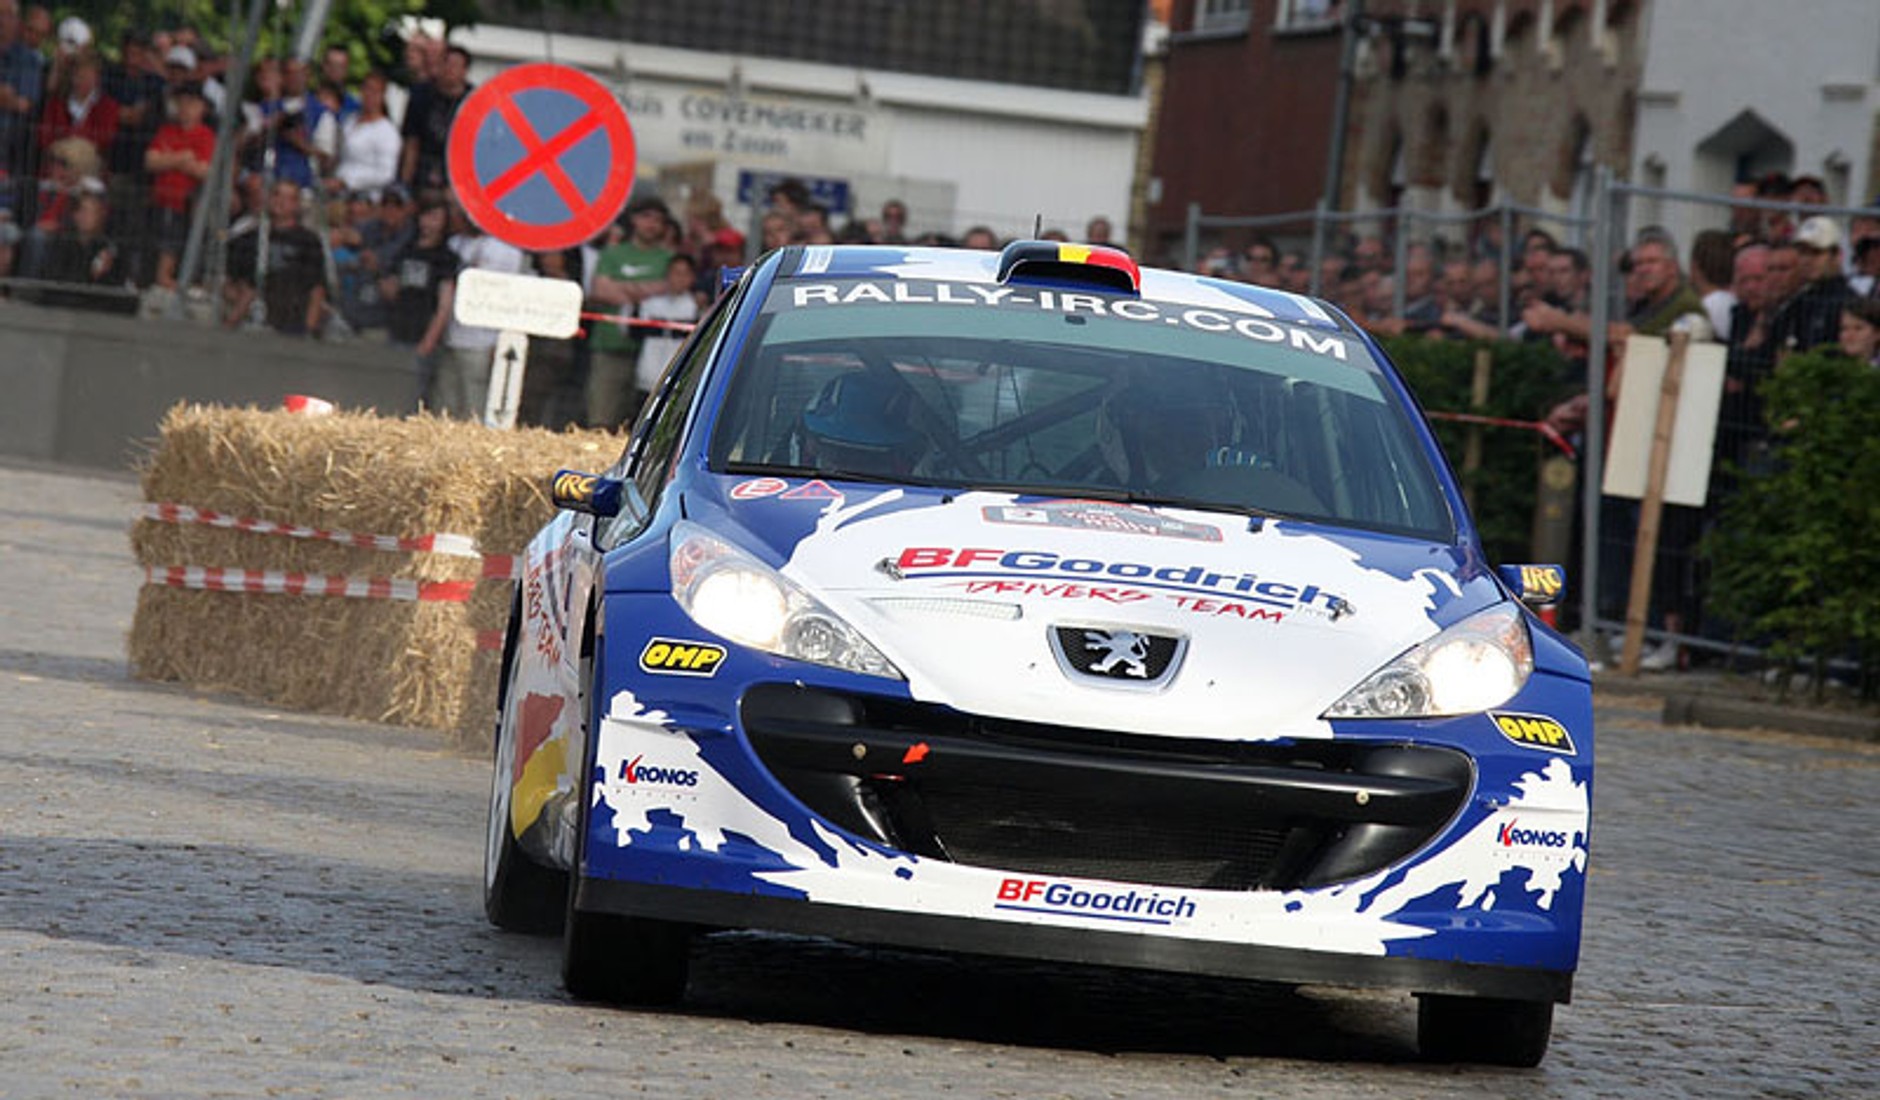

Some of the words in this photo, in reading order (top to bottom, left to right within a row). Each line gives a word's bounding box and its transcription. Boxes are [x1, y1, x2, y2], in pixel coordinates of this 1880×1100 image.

[793, 282, 1347, 360] RALLY-IRC.COM
[555, 474, 597, 501] IRC
[898, 547, 1341, 610] BFGoodrich
[1521, 565, 1562, 595] IRC
[964, 580, 1153, 605] DRIVERS
[1167, 595, 1286, 623] TEAM
[644, 643, 721, 669] OMP
[1499, 716, 1565, 745] OMP
[618, 754, 699, 786] KRONOS
[1497, 818, 1567, 847] KRONOS
[997, 879, 1197, 918] BFGoodrich
